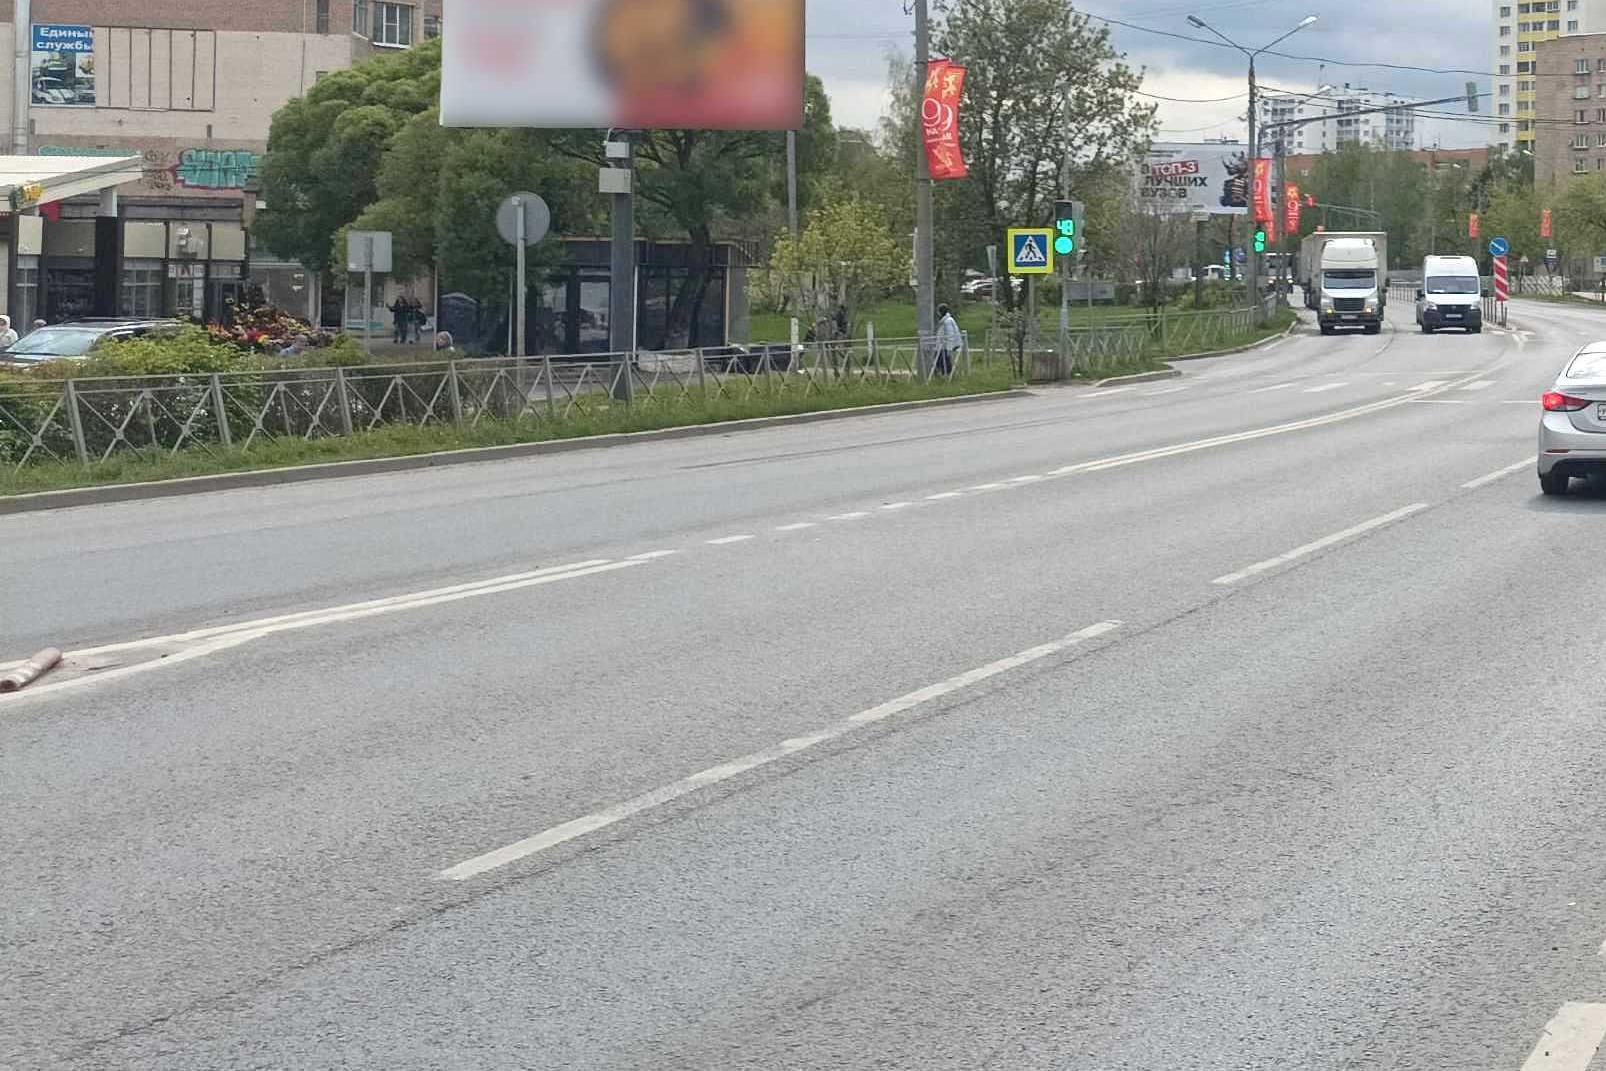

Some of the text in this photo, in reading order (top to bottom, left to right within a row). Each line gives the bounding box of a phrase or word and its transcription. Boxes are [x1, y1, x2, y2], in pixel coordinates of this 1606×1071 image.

[922, 97, 941, 128] 9
[1152, 161, 1196, 176] ТОП-3
[1144, 175, 1208, 187] ЛУЧШИХ
